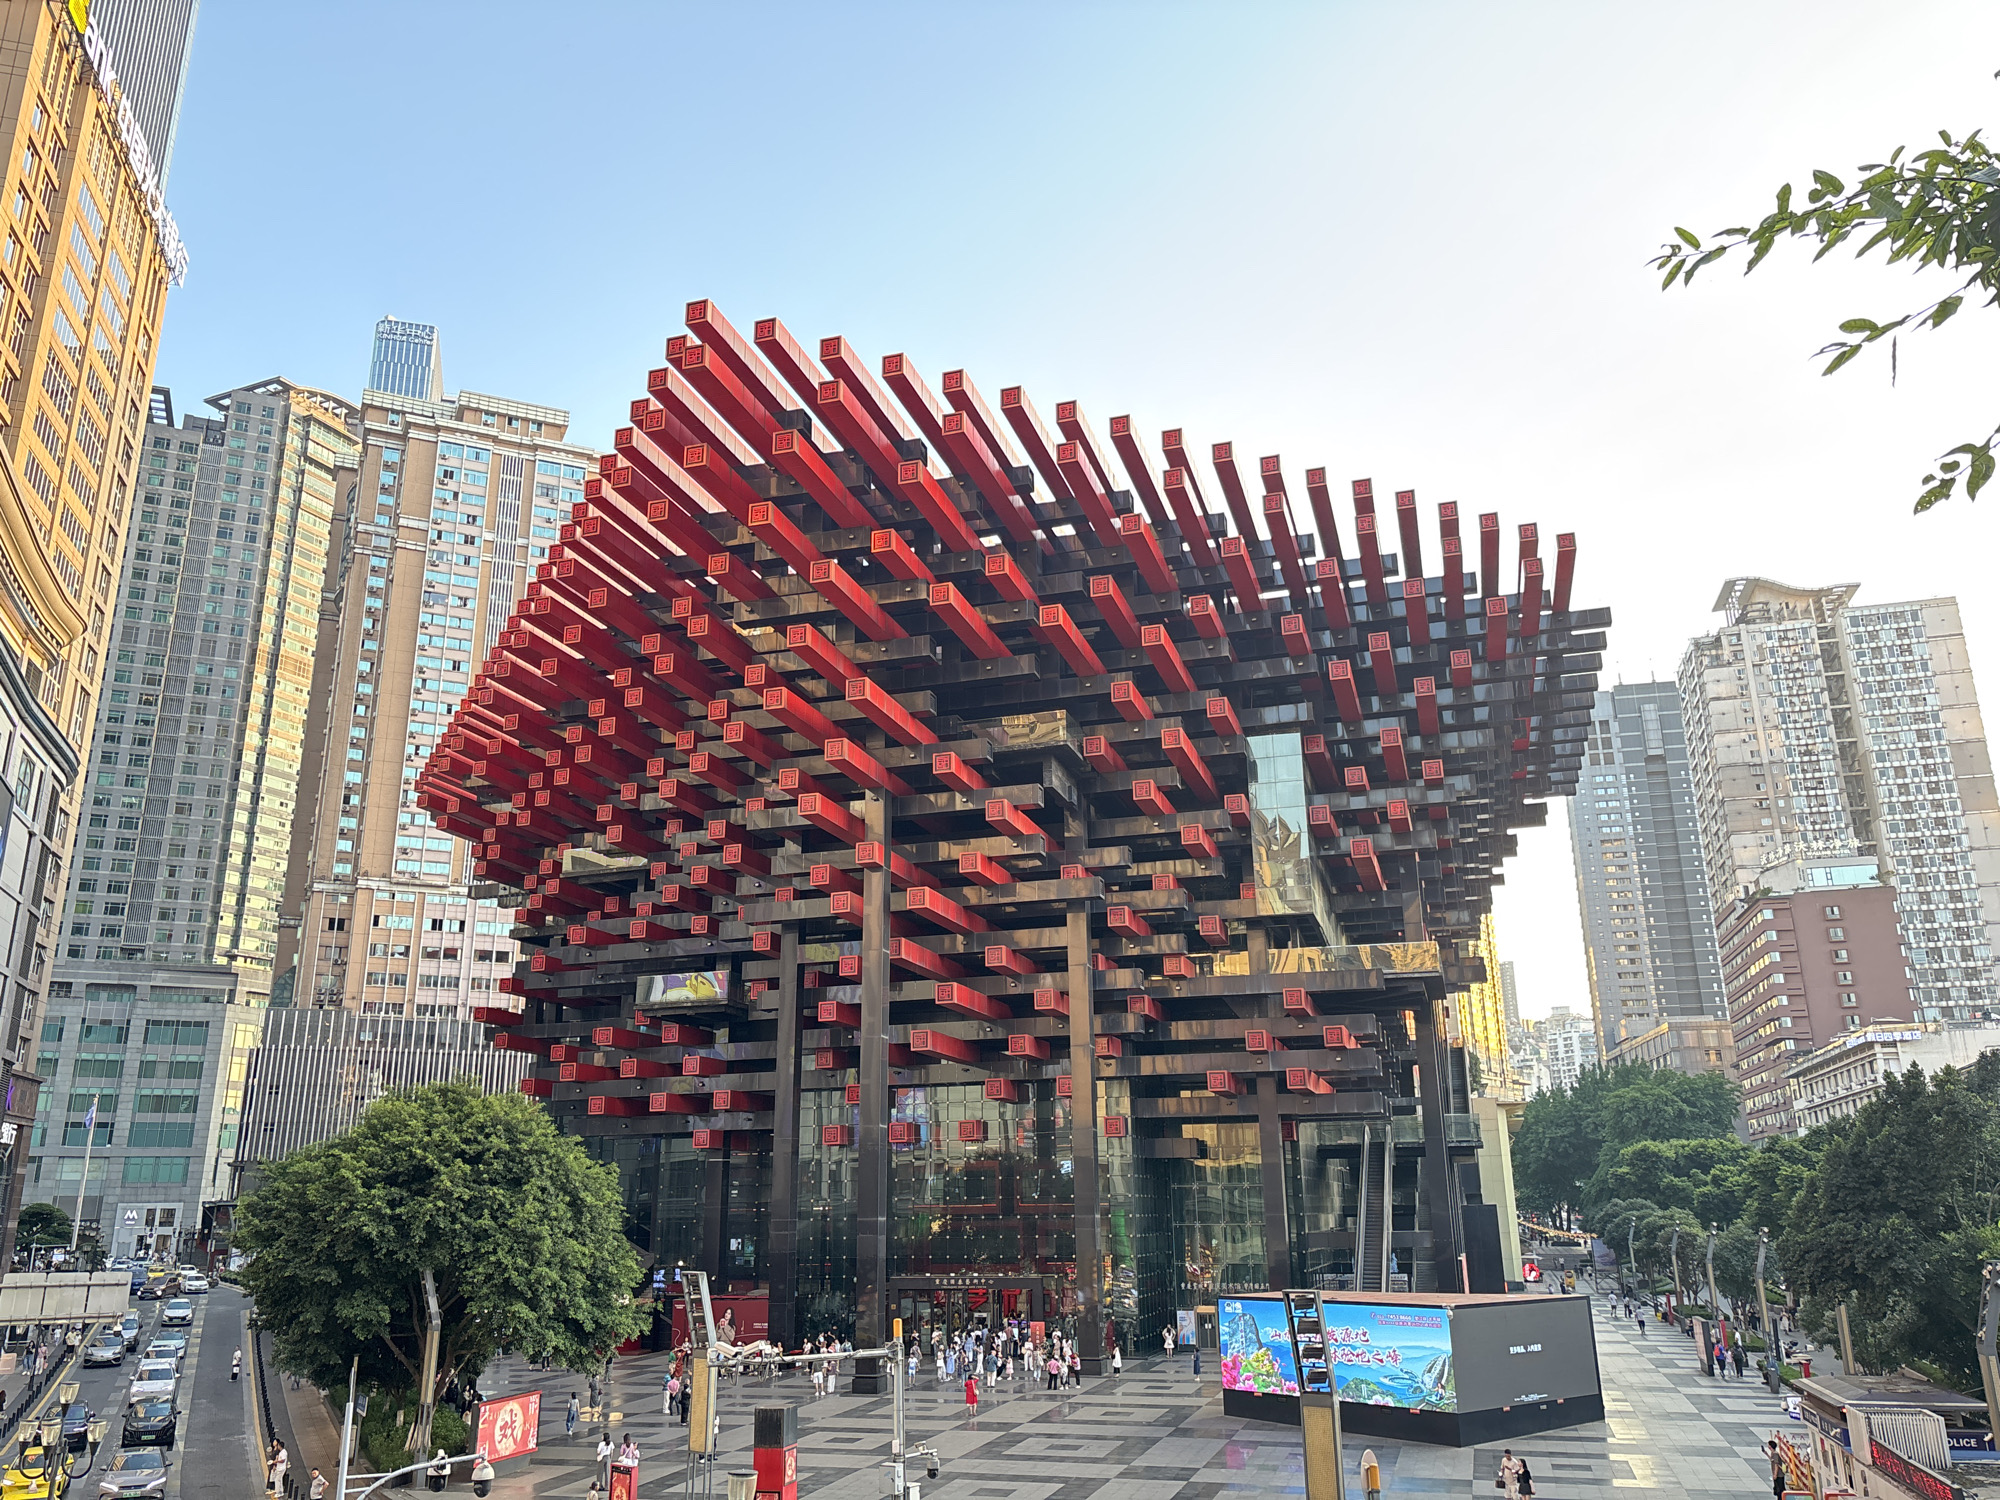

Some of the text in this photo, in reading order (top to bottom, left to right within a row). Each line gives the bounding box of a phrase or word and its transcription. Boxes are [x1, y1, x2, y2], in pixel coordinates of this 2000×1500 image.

[378, 323, 433, 340] 新华中心
[1947, 1437, 1978, 1448] OLICE
